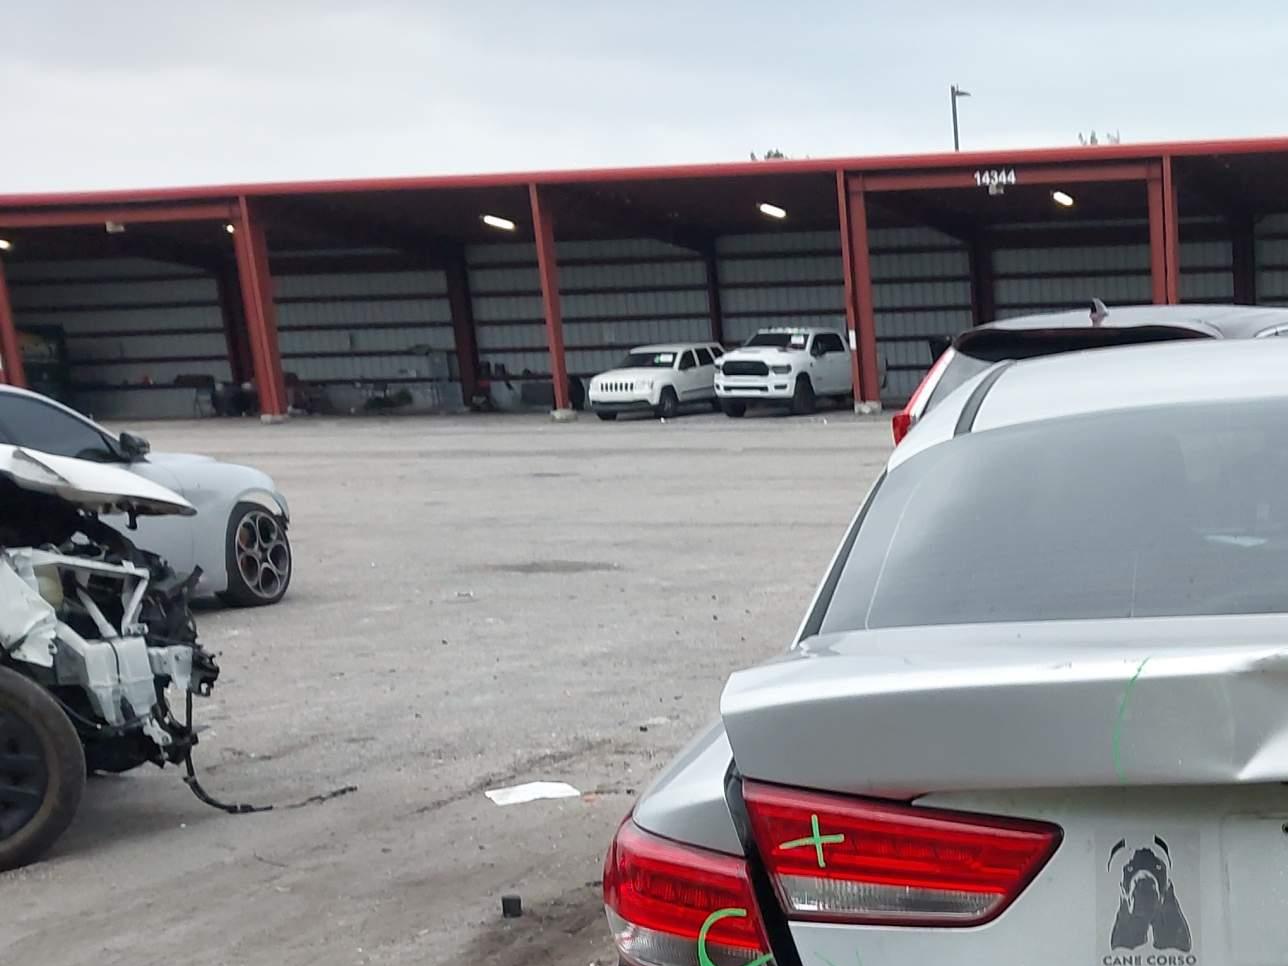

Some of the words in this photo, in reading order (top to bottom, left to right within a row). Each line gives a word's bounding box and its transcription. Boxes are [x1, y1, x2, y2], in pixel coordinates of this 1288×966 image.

[974, 168, 1016, 186] 14344
[1103, 955, 1142, 966] CANE
[1147, 955, 1196, 966] CORSO
